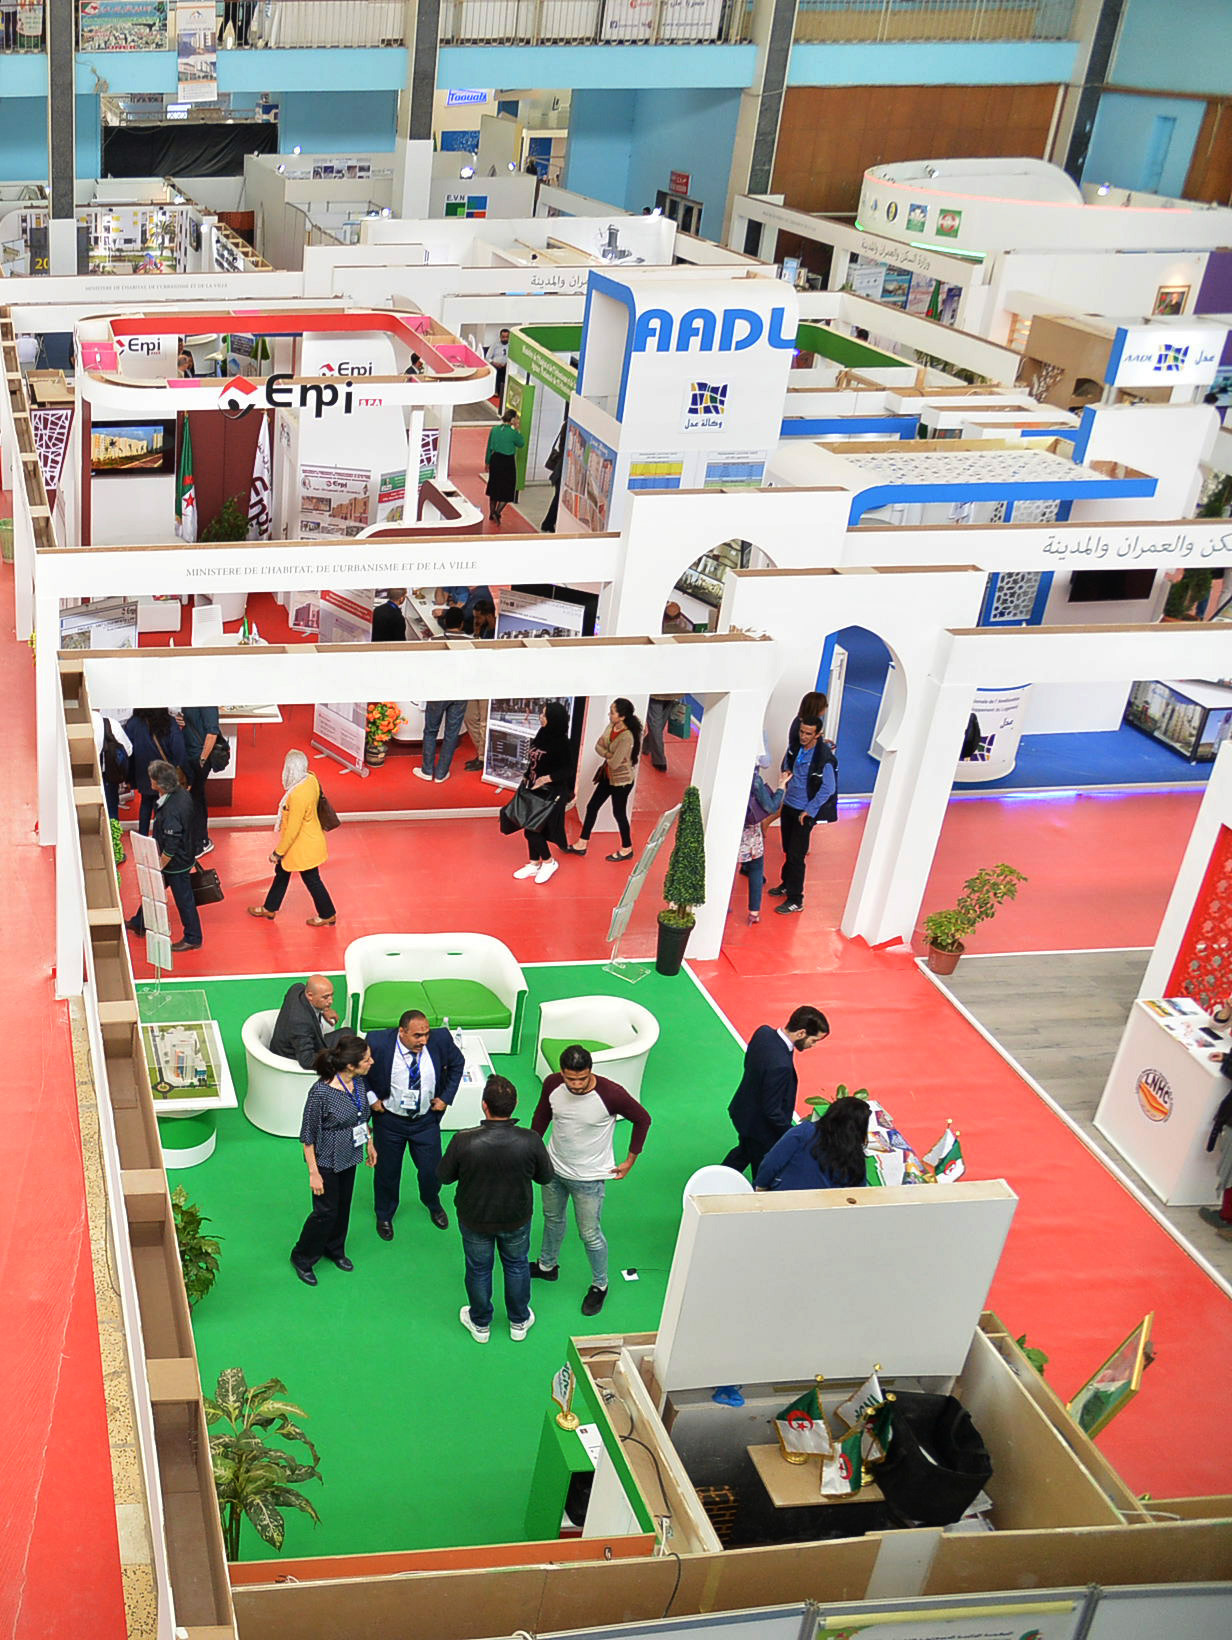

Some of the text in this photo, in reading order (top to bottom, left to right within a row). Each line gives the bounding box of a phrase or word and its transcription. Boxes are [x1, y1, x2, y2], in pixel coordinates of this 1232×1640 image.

[530, 274, 566, 288] والمدينة
[632, 307, 796, 352] AADL
[684, 418, 699, 430] عدل
[1042, 536, 1110, 560] والمدينة
[1117, 535, 1194, 560] والعمران
[186, 567, 242, 577] MINISTERE
[244, 566, 258, 576] DE
[316, 564, 330, 574] DE
[401, 562, 414, 572] ET
[417, 562, 431, 571] DE
[434, 562, 446, 570] LA
[448, 561, 477, 570] VILLE
